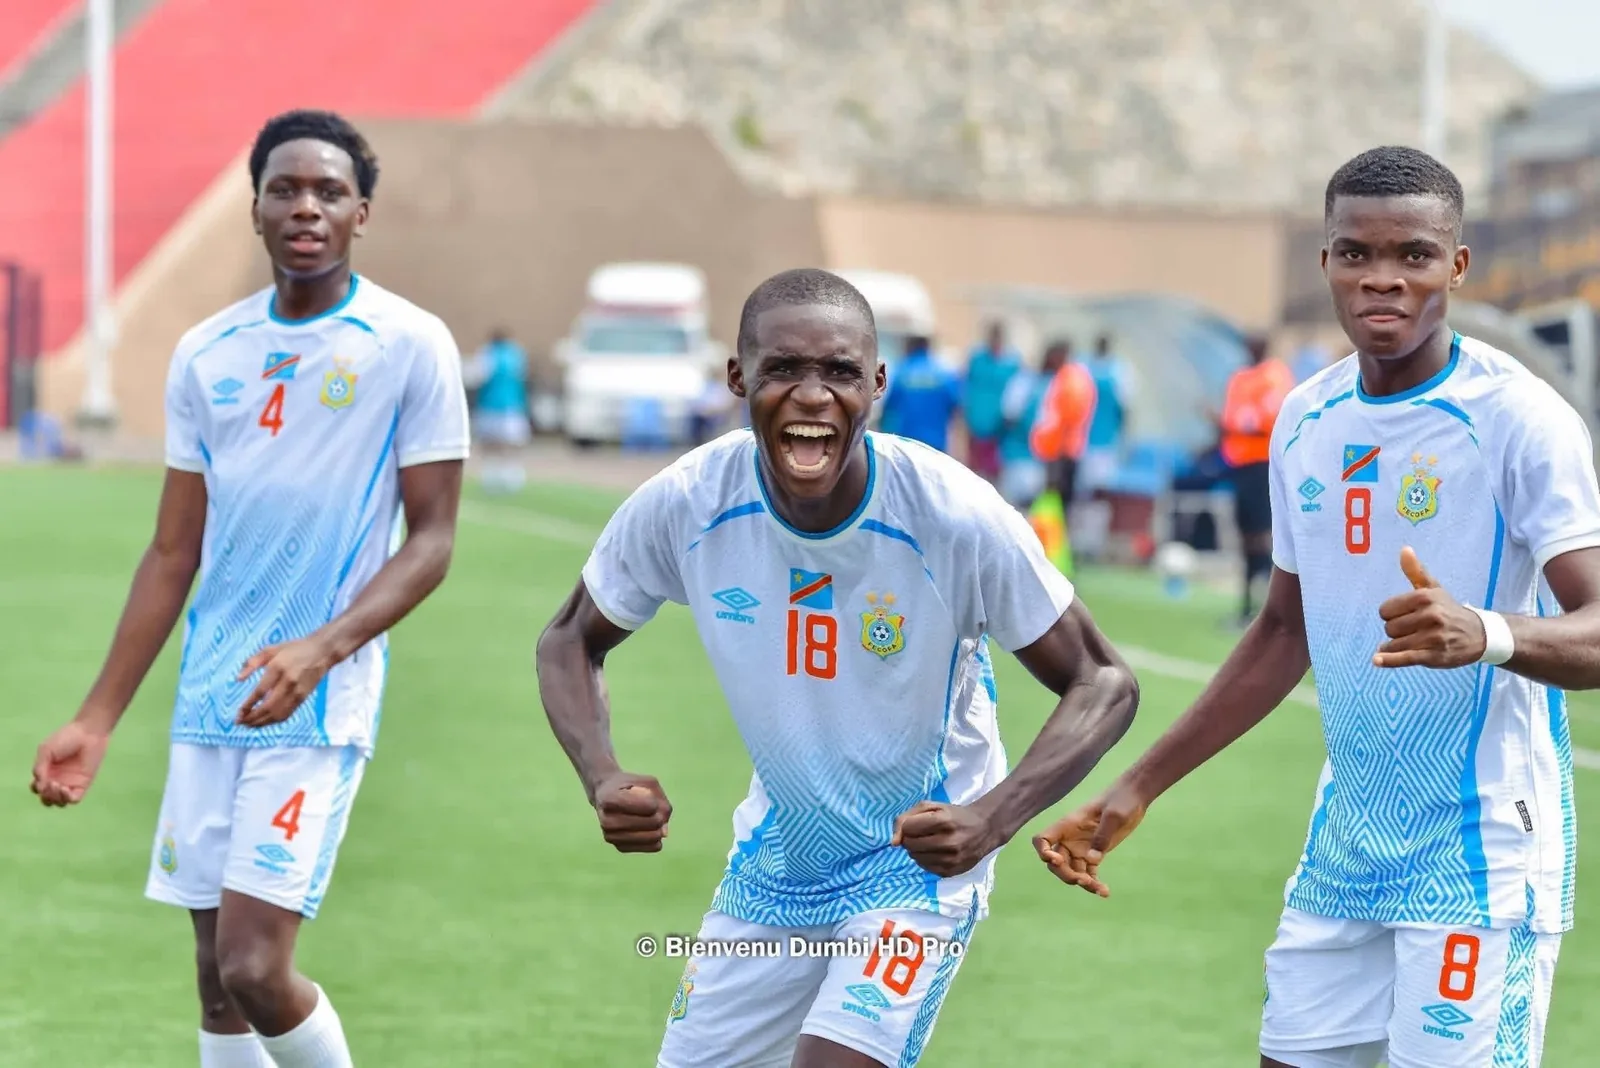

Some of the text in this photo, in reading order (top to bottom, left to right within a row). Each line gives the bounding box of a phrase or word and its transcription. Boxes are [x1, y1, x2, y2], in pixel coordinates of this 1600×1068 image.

[258, 383, 285, 438] 4
[1344, 487, 1372, 555] 8
[716, 610, 756, 625] umbro
[786, 609, 838, 680] 18
[270, 788, 306, 842] 4
[862, 918, 925, 997] 18
[1438, 932, 1480, 1001] 8
[841, 1001, 881, 1022] umbro
[1422, 1023, 1465, 1041] umbro
